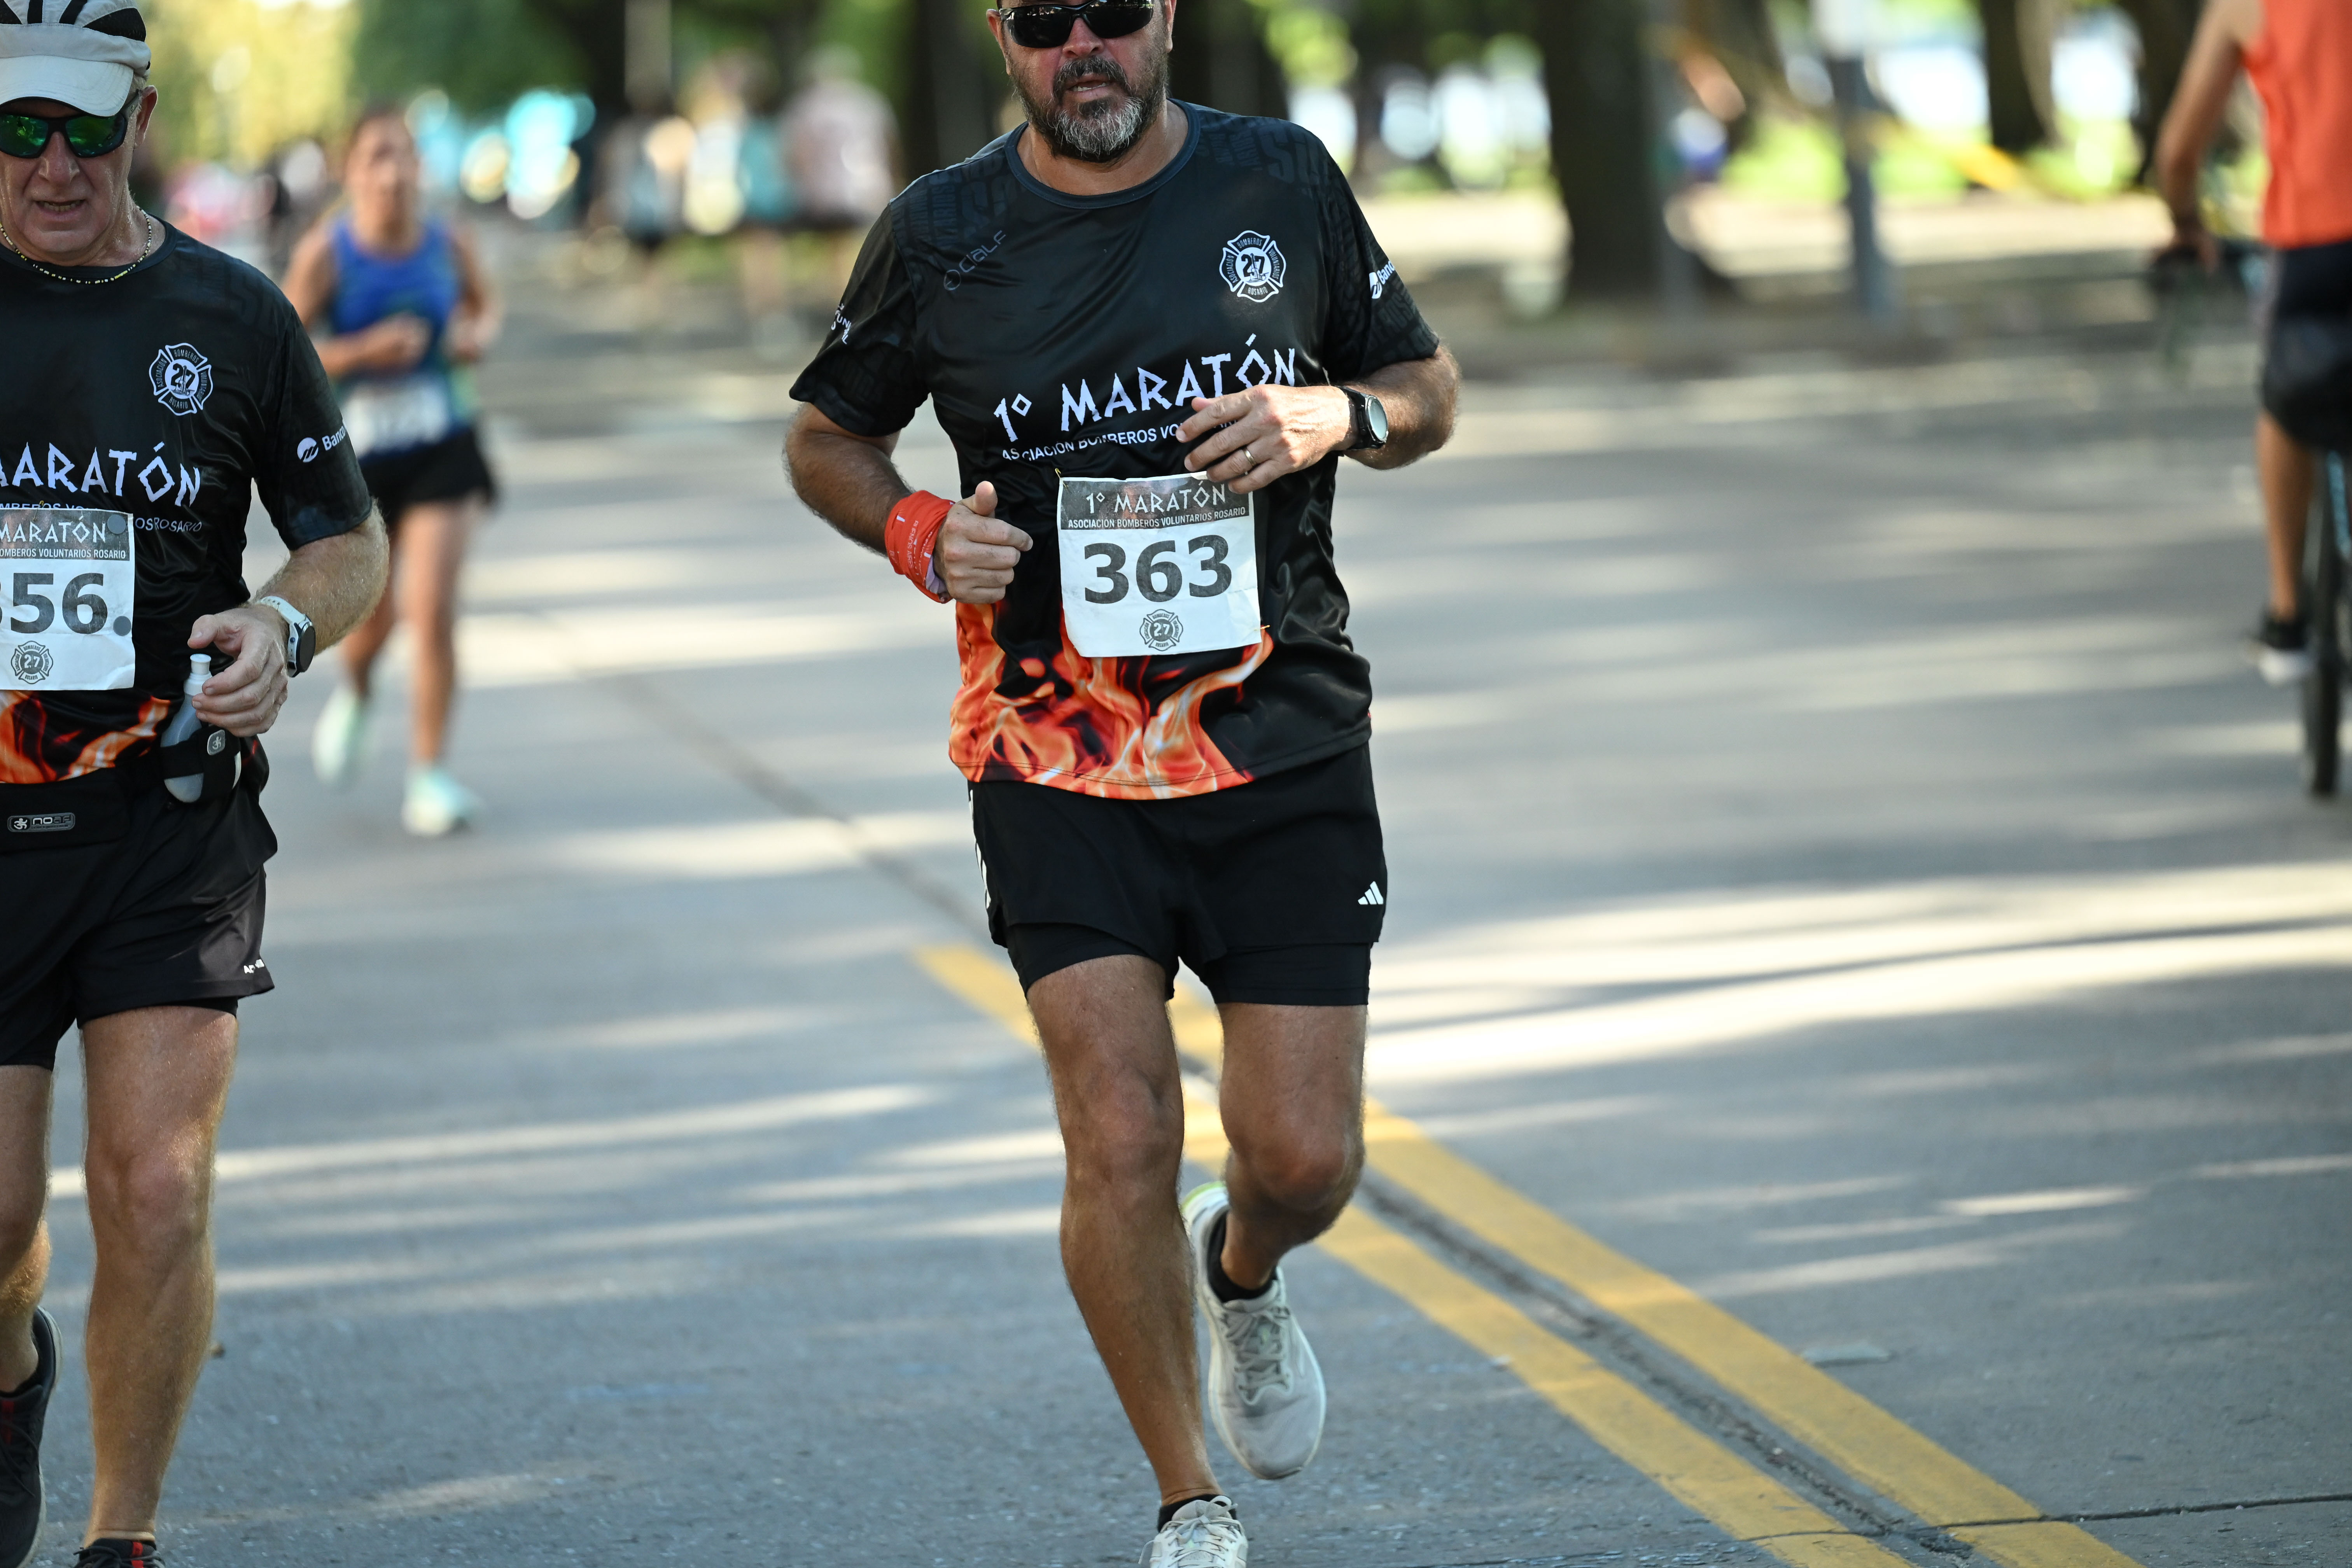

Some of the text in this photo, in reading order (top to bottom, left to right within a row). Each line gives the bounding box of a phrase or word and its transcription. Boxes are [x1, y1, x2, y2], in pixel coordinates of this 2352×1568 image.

[1237, 238, 1262, 248] BOMBEROS
[1241, 254, 1265, 277] 27
[1269, 248, 1280, 279] VOLUNTARIOS
[1248, 286, 1268, 296] ROSARIO
[174, 349, 199, 363] BOMBEROS
[171, 363, 195, 389] 27
[1061, 333, 1295, 431] MARATÓN
[169, 397, 188, 409] ROSARIO
[0, 441, 200, 507] ARATÓN
[1114, 481, 1225, 513] MARATÓN
[1068, 507, 1245, 528] ASOCIACIÓN BOMBEROS VOLUNTARIOS ROSARIO
[39, 549, 91, 558] VOLUNTARIOS
[94, 550, 126, 559] ROSARIO
[1084, 535, 1232, 604] 363
[0, 572, 108, 634] 56
[1153, 622, 1170, 637] 27
[24, 654, 40, 668] 27
